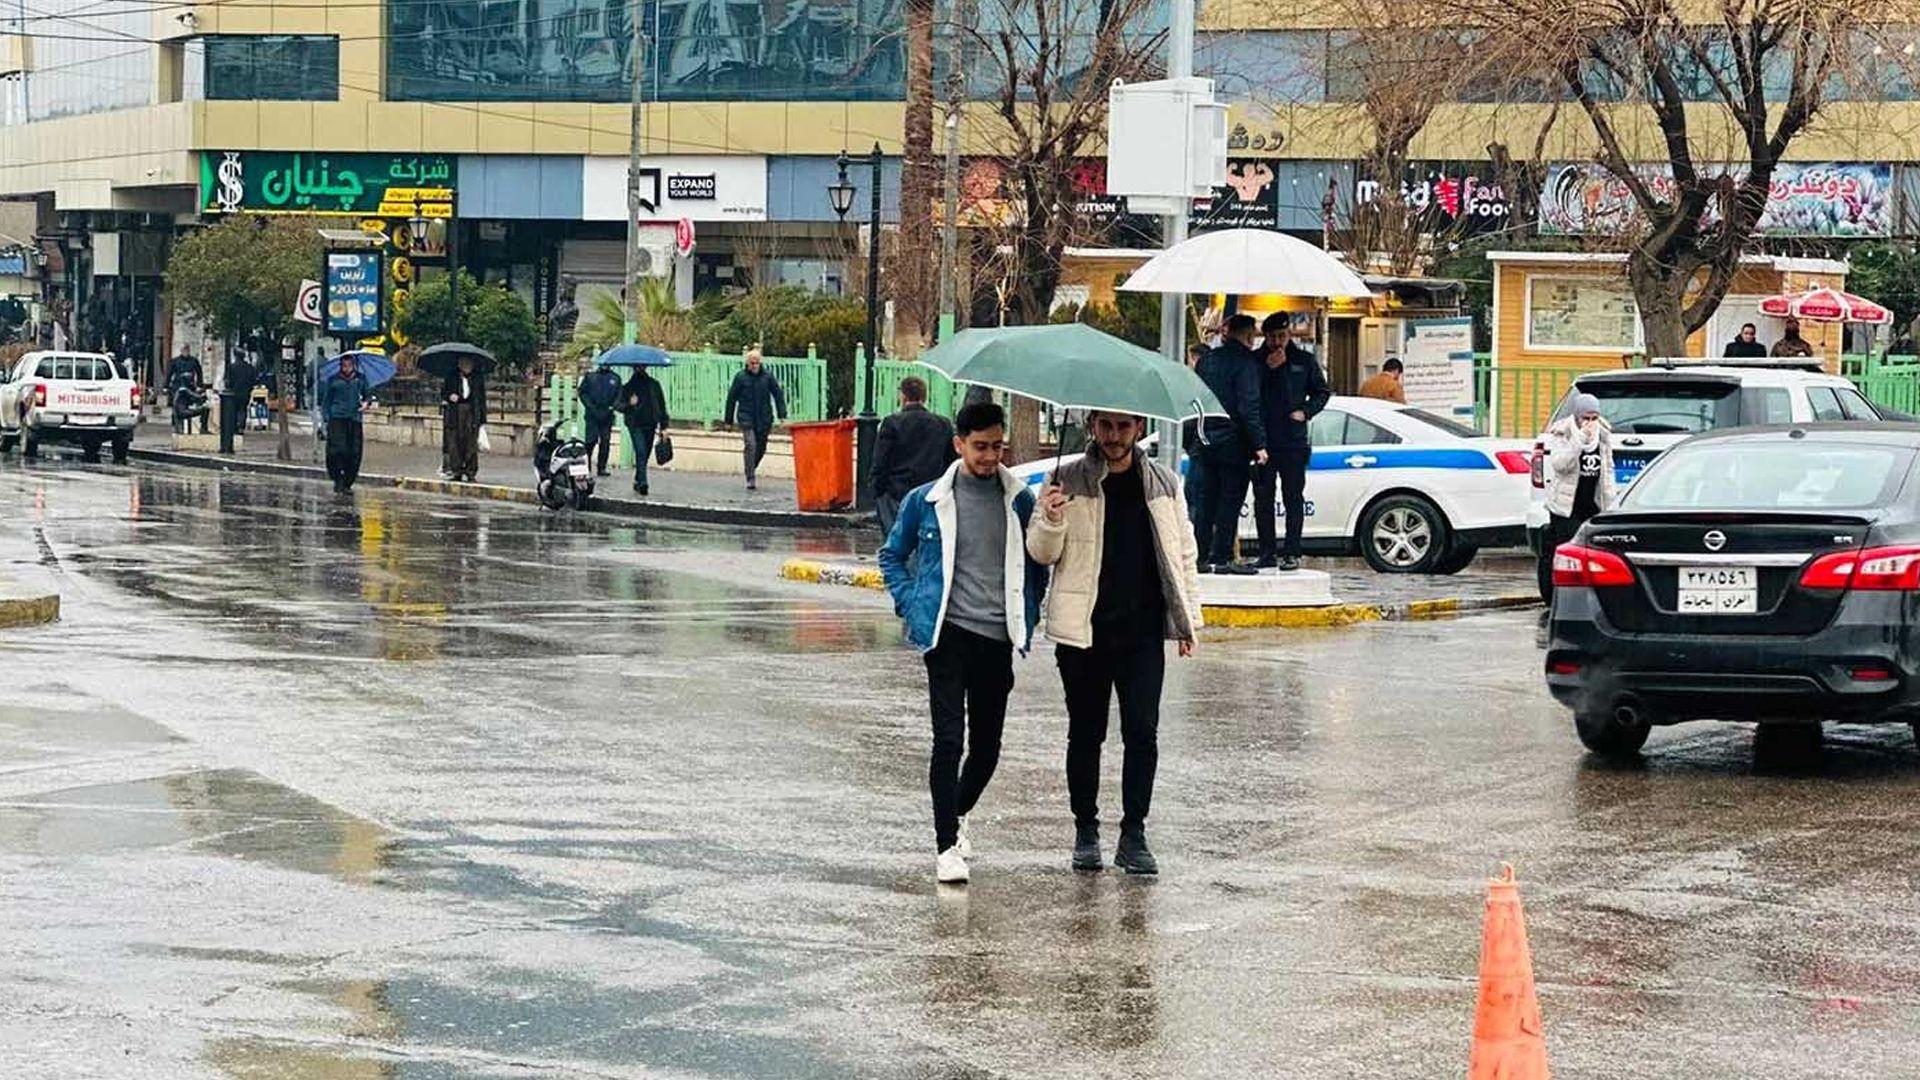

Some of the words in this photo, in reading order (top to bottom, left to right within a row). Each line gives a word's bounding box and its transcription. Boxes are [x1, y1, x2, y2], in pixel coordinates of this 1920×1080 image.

[389, 158, 450, 185] شركة
[670, 179, 714, 189] EXPAND
[670, 189, 688, 197] YOUR
[689, 189, 714, 197] WORLD
[58, 395, 120, 405] MITSUBISHI
